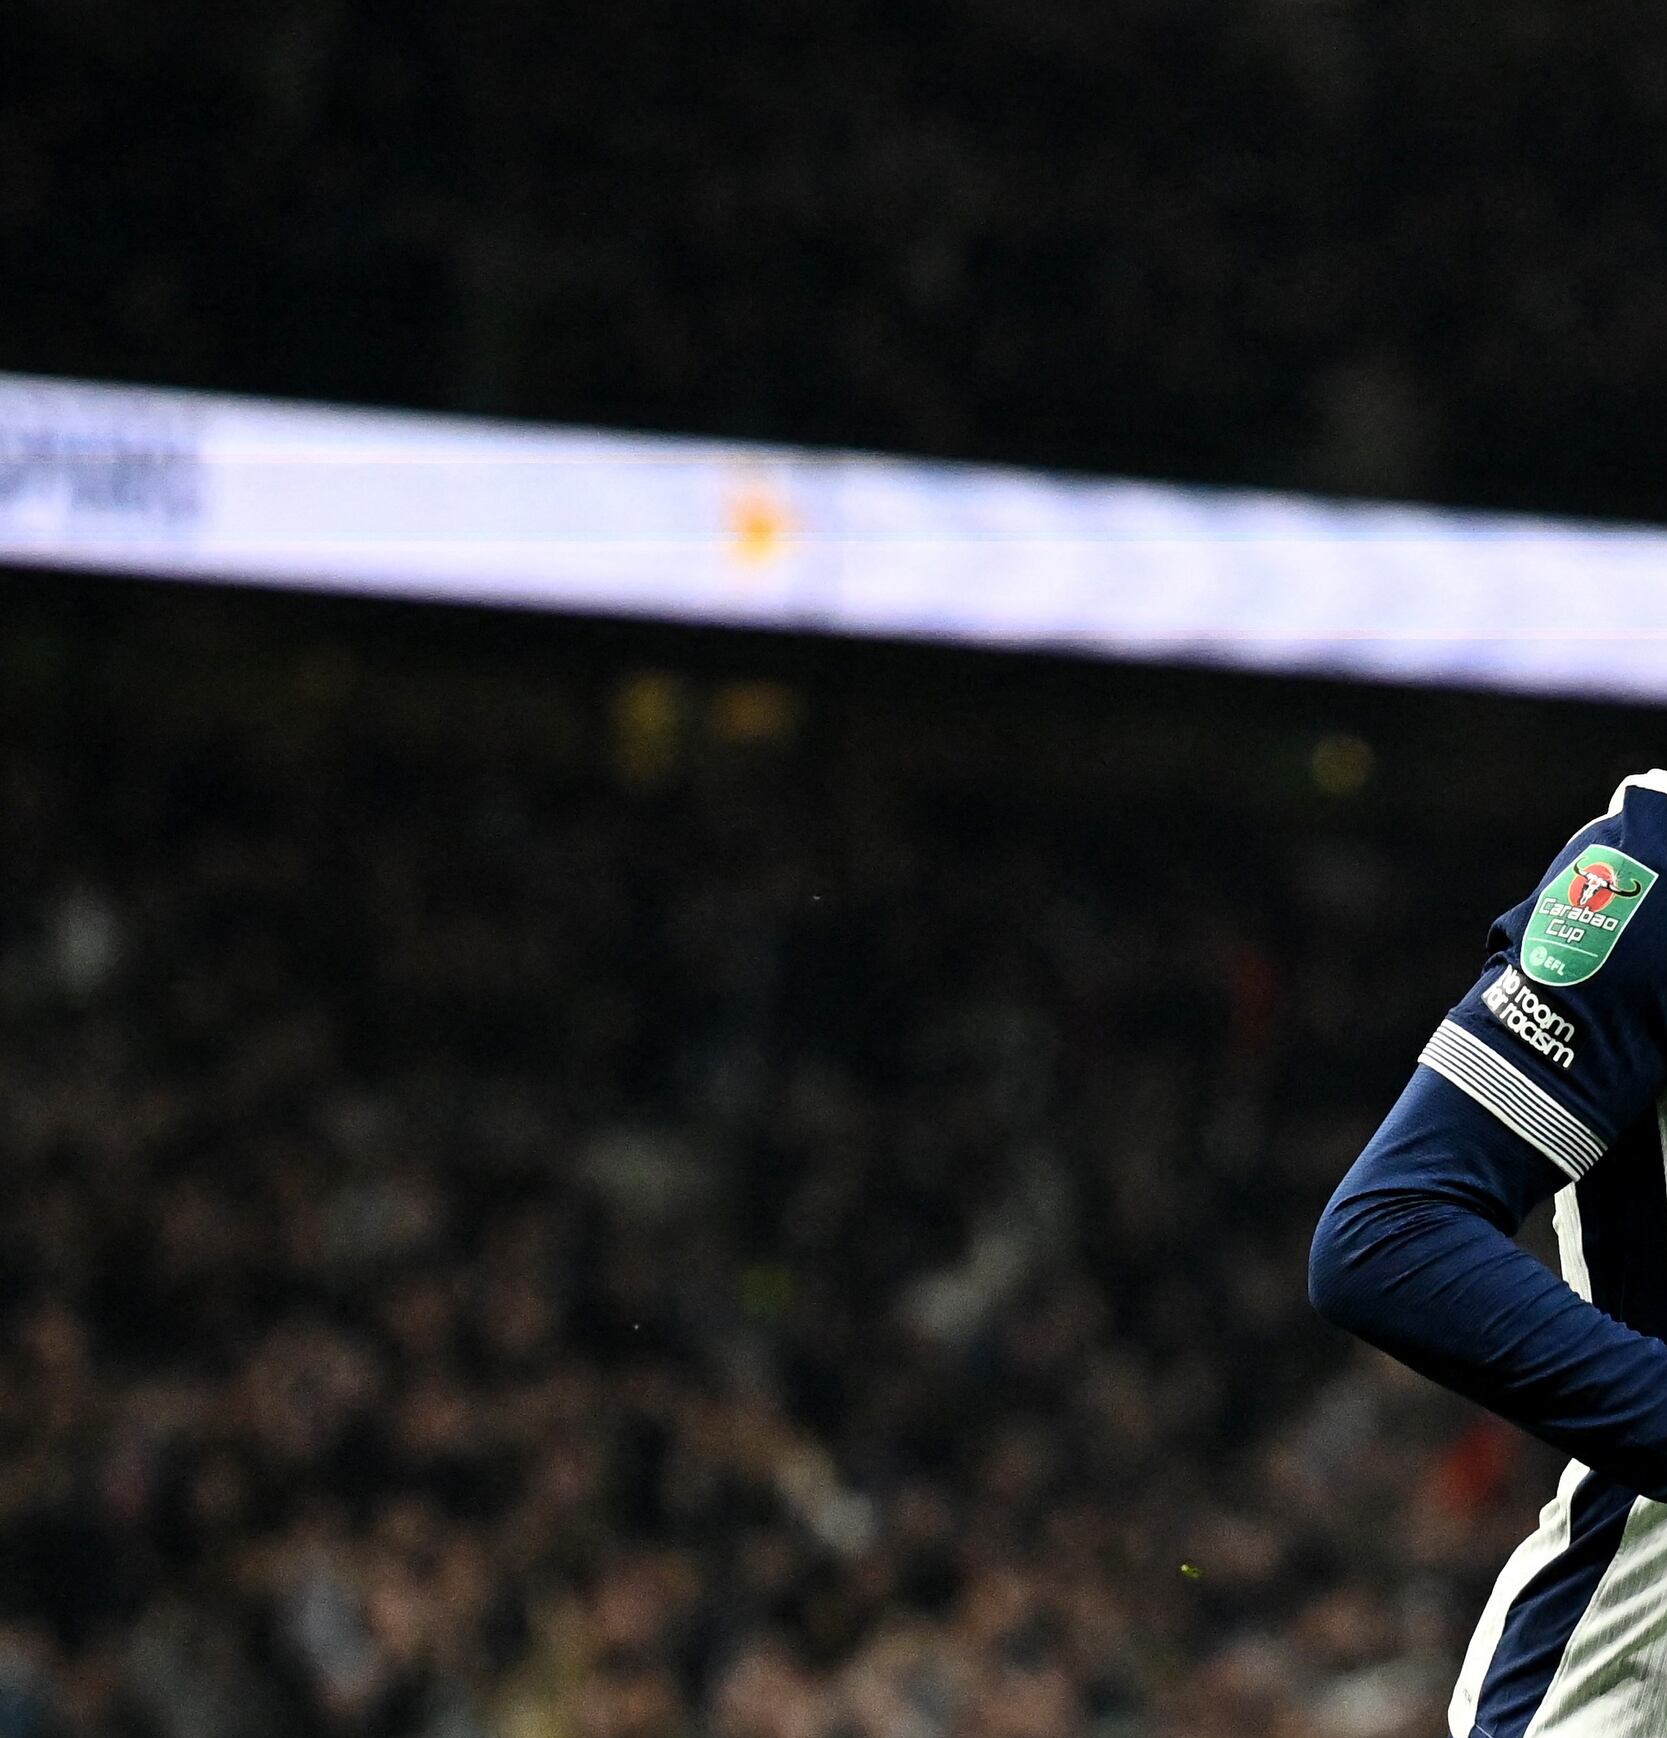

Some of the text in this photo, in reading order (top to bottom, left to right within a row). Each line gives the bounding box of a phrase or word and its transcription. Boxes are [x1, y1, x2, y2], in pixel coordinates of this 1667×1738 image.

[1538, 897, 1619, 932] Carabao
[1545, 918, 1585, 943] Cup
[1543, 955, 1566, 976] EFL
[1514, 985, 1575, 1043] room
[1499, 1003, 1575, 1068] racism
